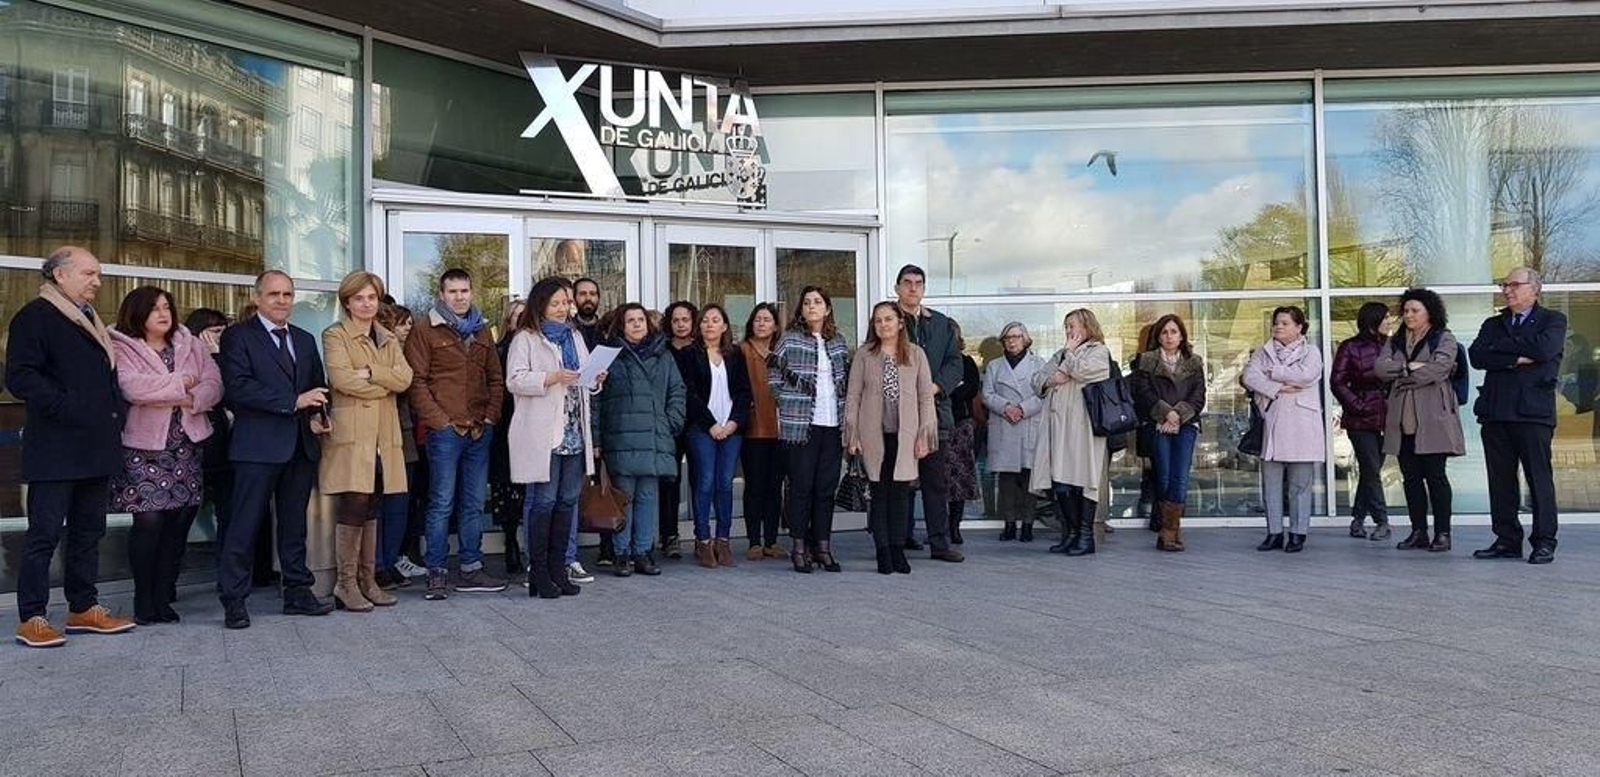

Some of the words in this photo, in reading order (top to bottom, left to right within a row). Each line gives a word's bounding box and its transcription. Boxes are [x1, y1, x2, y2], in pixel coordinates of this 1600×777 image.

[519, 53, 764, 198] XUNTA
[600, 126, 630, 146] DE
[637, 131, 726, 153] GALICIA
[673, 172, 728, 193] GALICI
